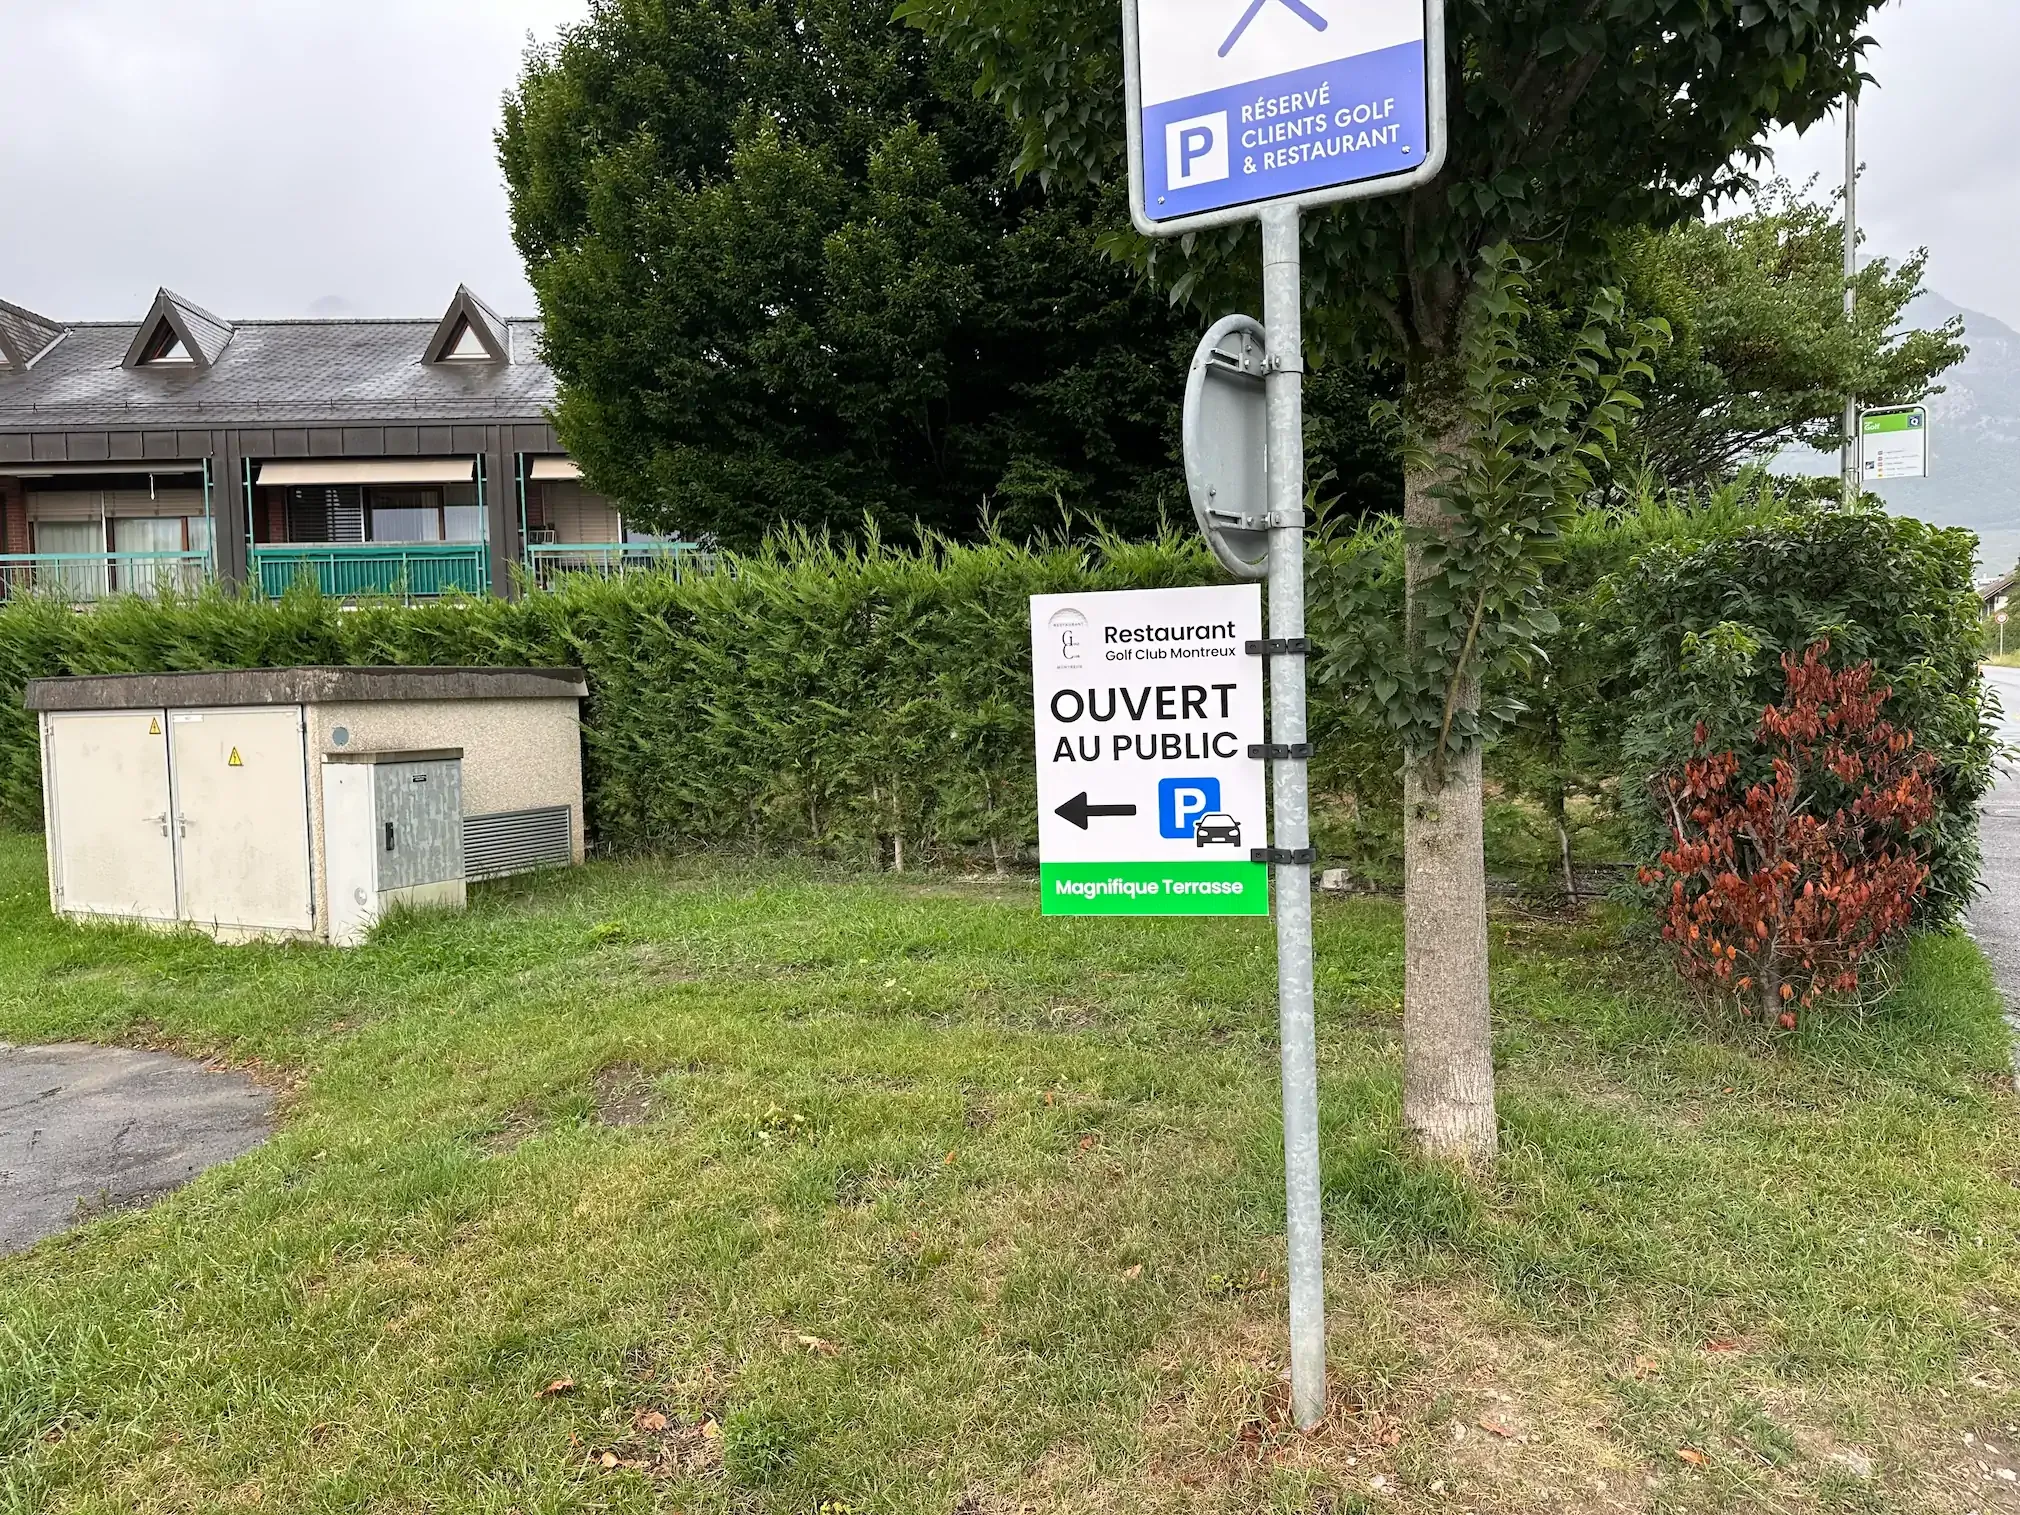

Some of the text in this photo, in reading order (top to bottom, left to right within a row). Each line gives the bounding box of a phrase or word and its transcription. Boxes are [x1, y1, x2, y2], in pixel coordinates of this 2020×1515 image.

[1241, 81, 1330, 123] RÉSERVÉ
[1241, 98, 1394, 149] CLIENTS GOLF
[1179, 127, 1214, 178] P
[1243, 124, 1400, 175] & RESTAURANT
[1104, 621, 1236, 644] Restaurant
[1105, 647, 1236, 661] Golf Club Montreux
[1050, 683, 1237, 723] OUVERT
[1053, 731, 1239, 762] AU PUBLIC
[1174, 788, 1206, 829] P
[1055, 878, 1243, 900] Magnifique Terrasse
